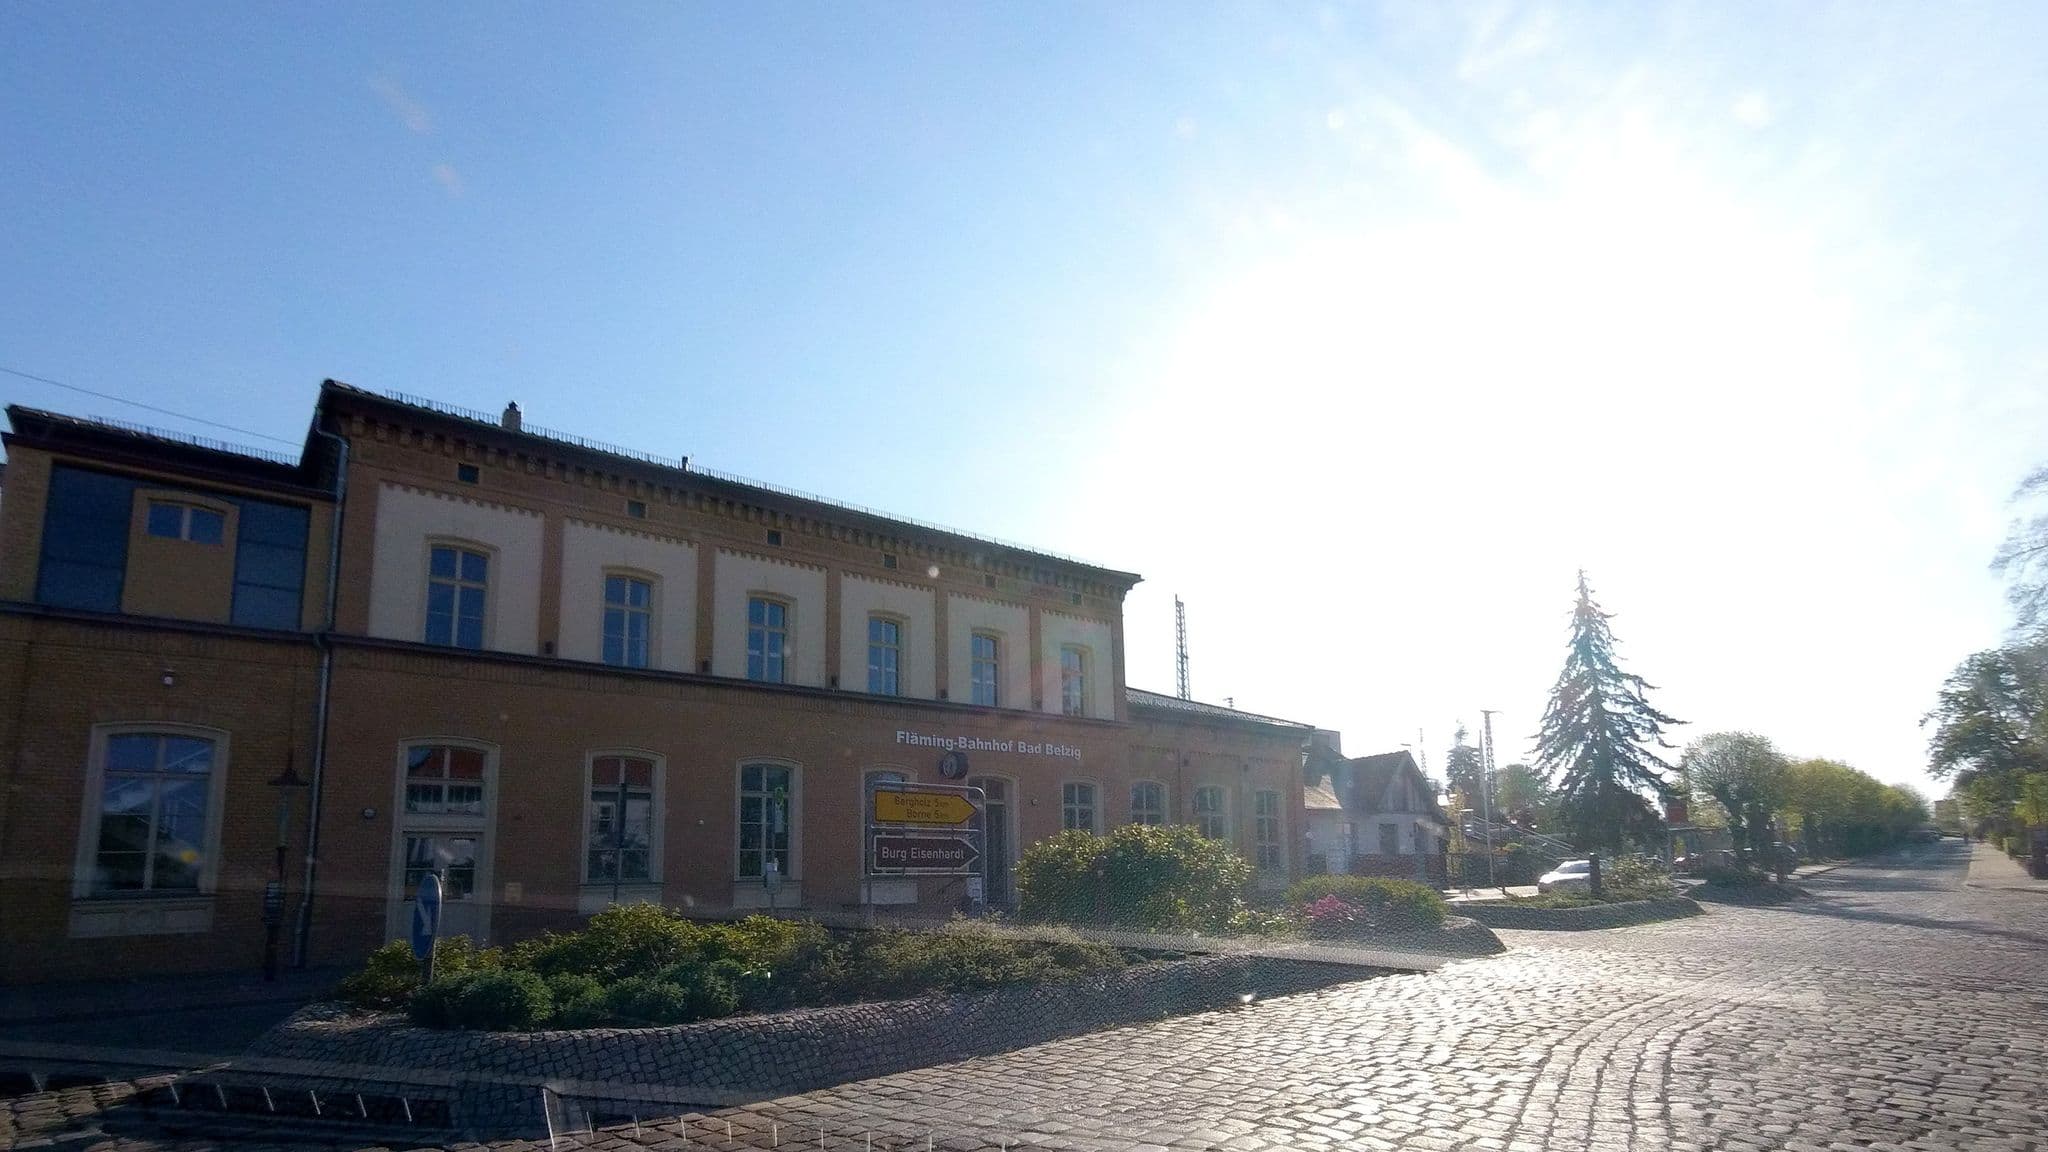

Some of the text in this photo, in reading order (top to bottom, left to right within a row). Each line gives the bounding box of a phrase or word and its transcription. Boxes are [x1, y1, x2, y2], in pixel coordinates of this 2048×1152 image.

[896, 730, 1082, 760] Fläming-Bahnhof Bad Belzig
[895, 795, 931, 808] Bergholz
[881, 846, 965, 861] Burg Eisenhardt
